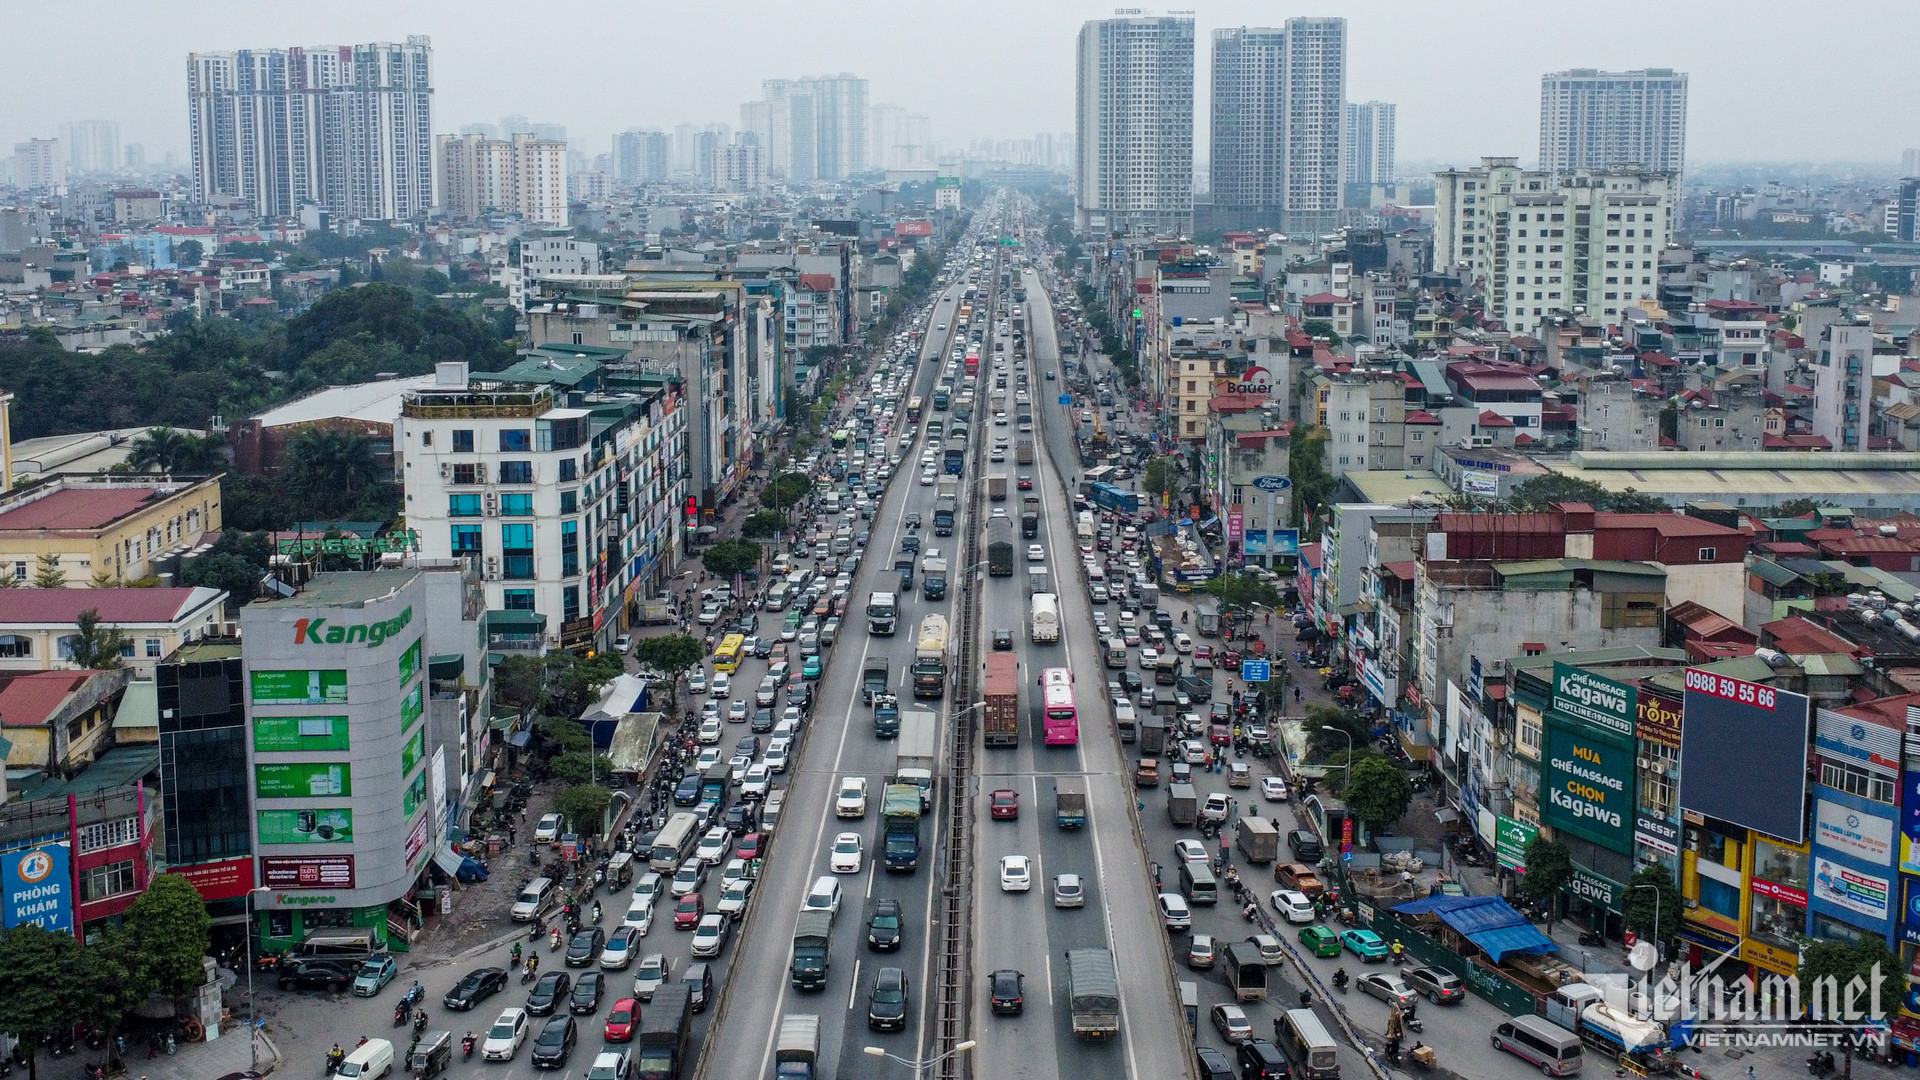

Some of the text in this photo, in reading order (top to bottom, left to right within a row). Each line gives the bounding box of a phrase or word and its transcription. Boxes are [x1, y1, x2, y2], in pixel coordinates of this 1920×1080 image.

[1259, 478, 1284, 488] Ford
[1560, 676, 1627, 714] Kagawa
[1571, 673, 1626, 698] GHẾ MASSAGE
[1686, 670, 1774, 708] 0988 59 55 66
[1636, 703, 1682, 730] TOPY
[1572, 744, 1602, 764] MUA
[1551, 758, 1622, 790] GHẾ MASSAGE
[1567, 780, 1606, 804] CHỌN
[1550, 787, 1621, 828] Kagawa
[1637, 818, 1676, 838] caesar
[14, 884, 60, 903] PHÒNG
[1580, 874, 1612, 892] MASSAGE
[16, 899, 58, 918] KHÁM
[49, 914, 58, 924] Y
